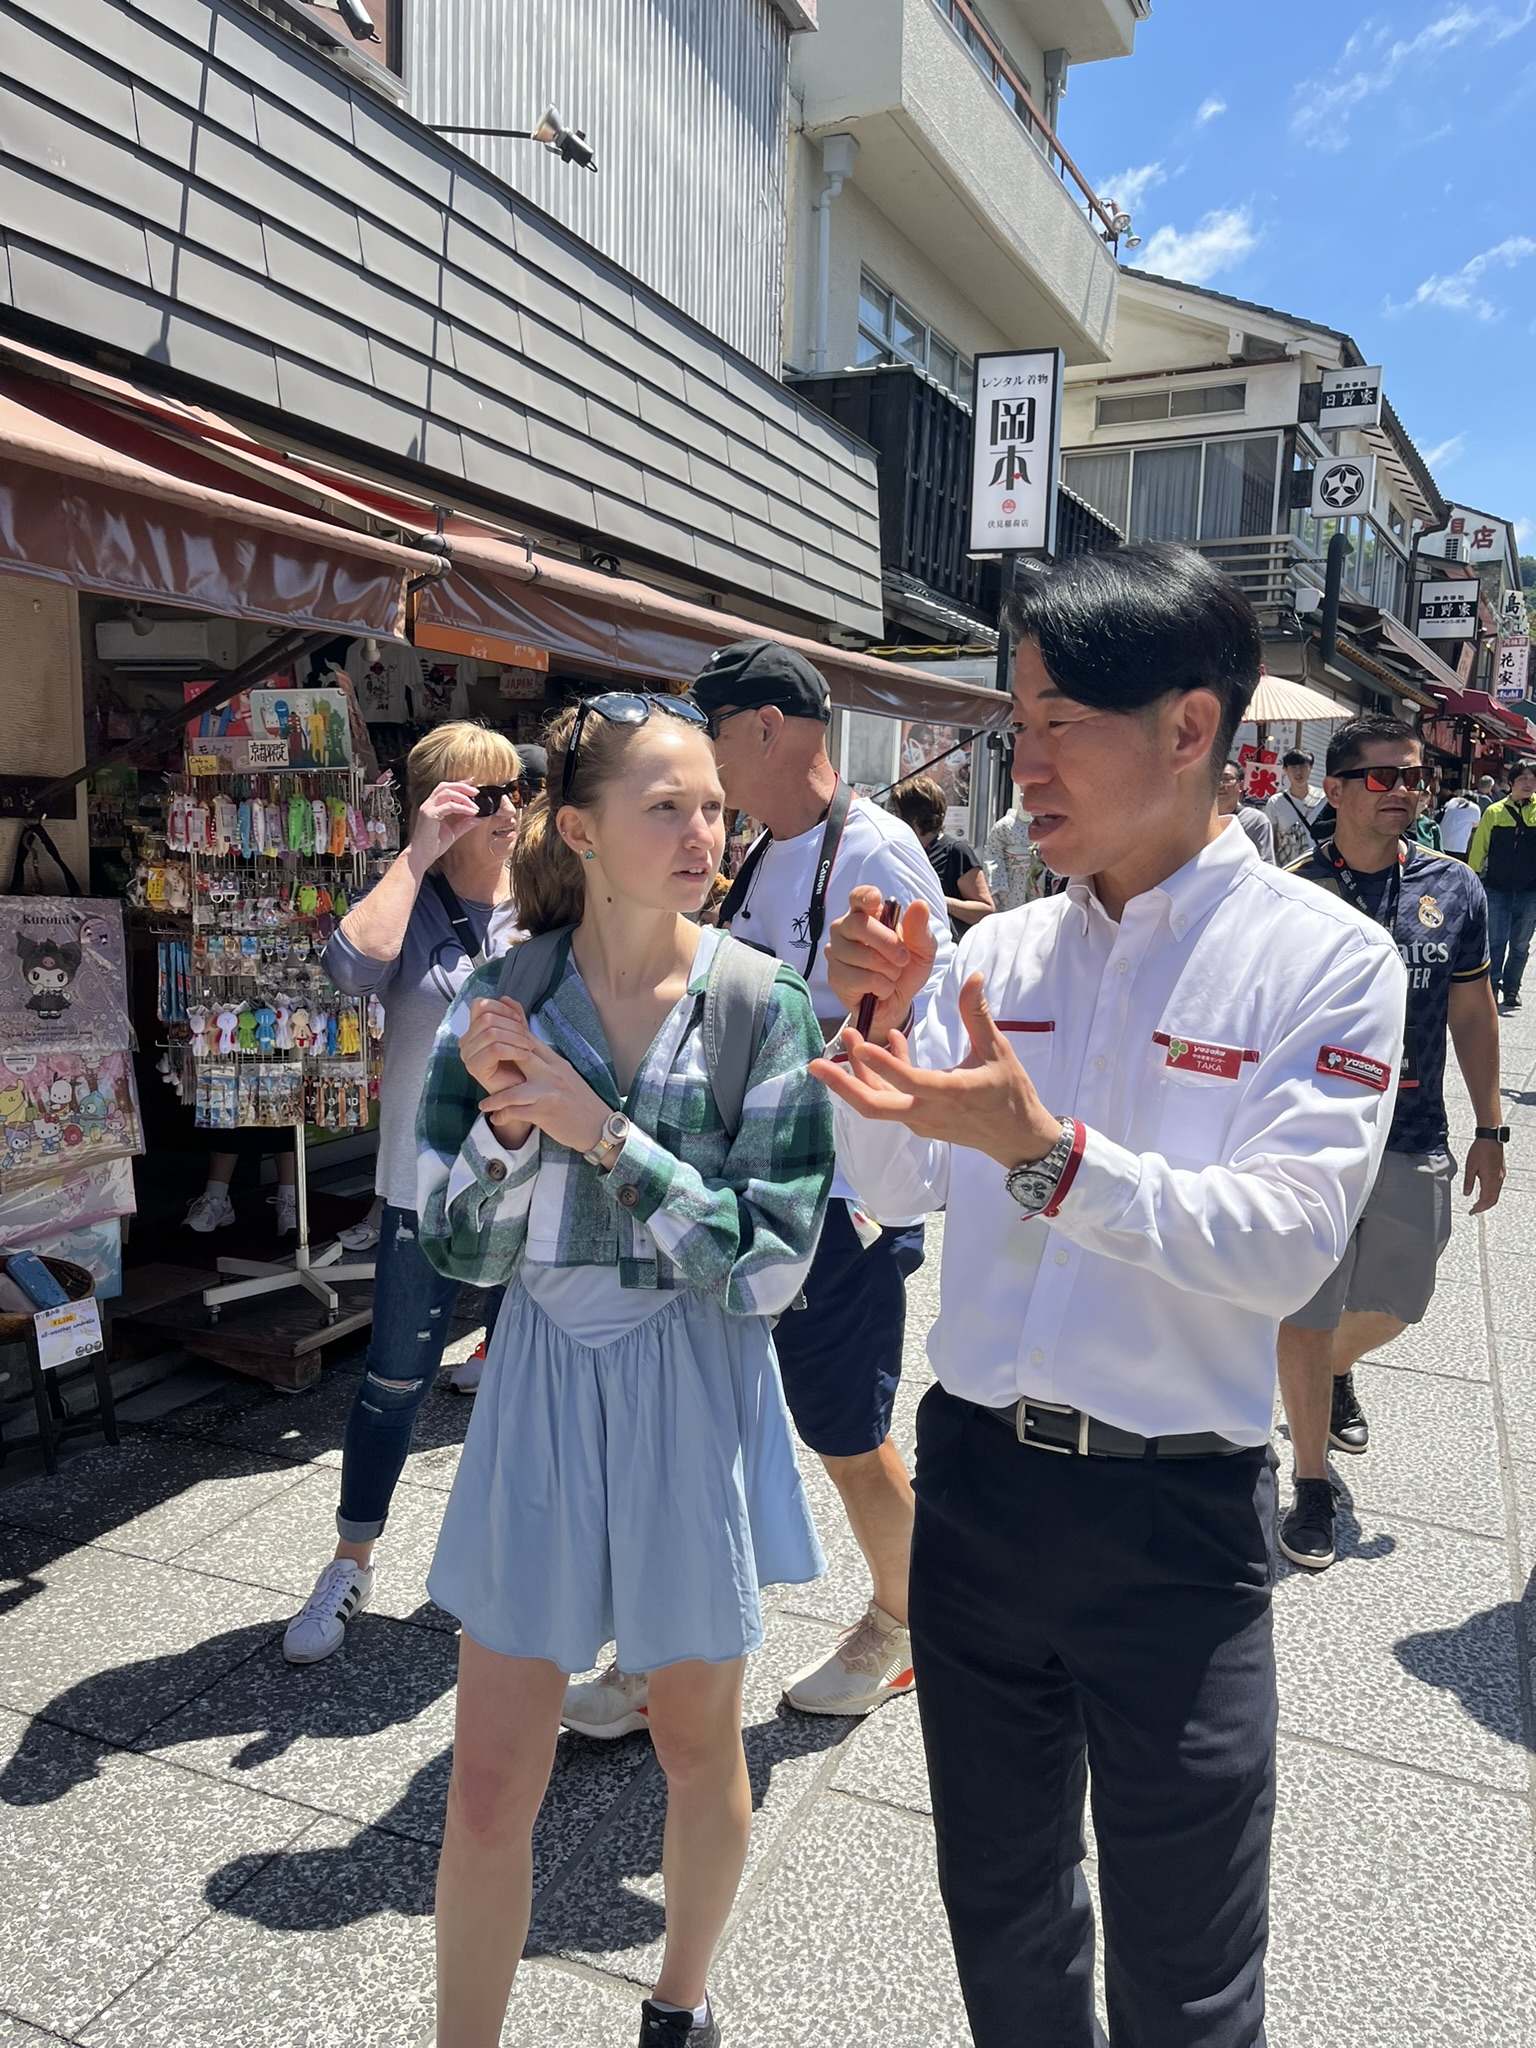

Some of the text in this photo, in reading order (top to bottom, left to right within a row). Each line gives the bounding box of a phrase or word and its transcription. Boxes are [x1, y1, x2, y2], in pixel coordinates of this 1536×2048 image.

[982, 374, 1049, 388] レンタル着物
[1325, 389, 1374, 407] 日野家
[988, 397, 1036, 491] 岡本
[987, 519, 1029, 529] 伏見稲荷店
[1420, 517, 1497, 550] 具店
[1424, 602, 1471, 617] 日野家
[1498, 651, 1516, 687] 花家
[1248, 769, 1277, 799] 氷
[816, 859, 830, 895] Canon
[23, 914, 70, 925] Kuromi
[1193, 1045, 1227, 1057] yasaka
[1196, 1060, 1222, 1072] TAKA
[1344, 1057, 1384, 1075] yasaka
[347, 1097, 358, 1106] 10
